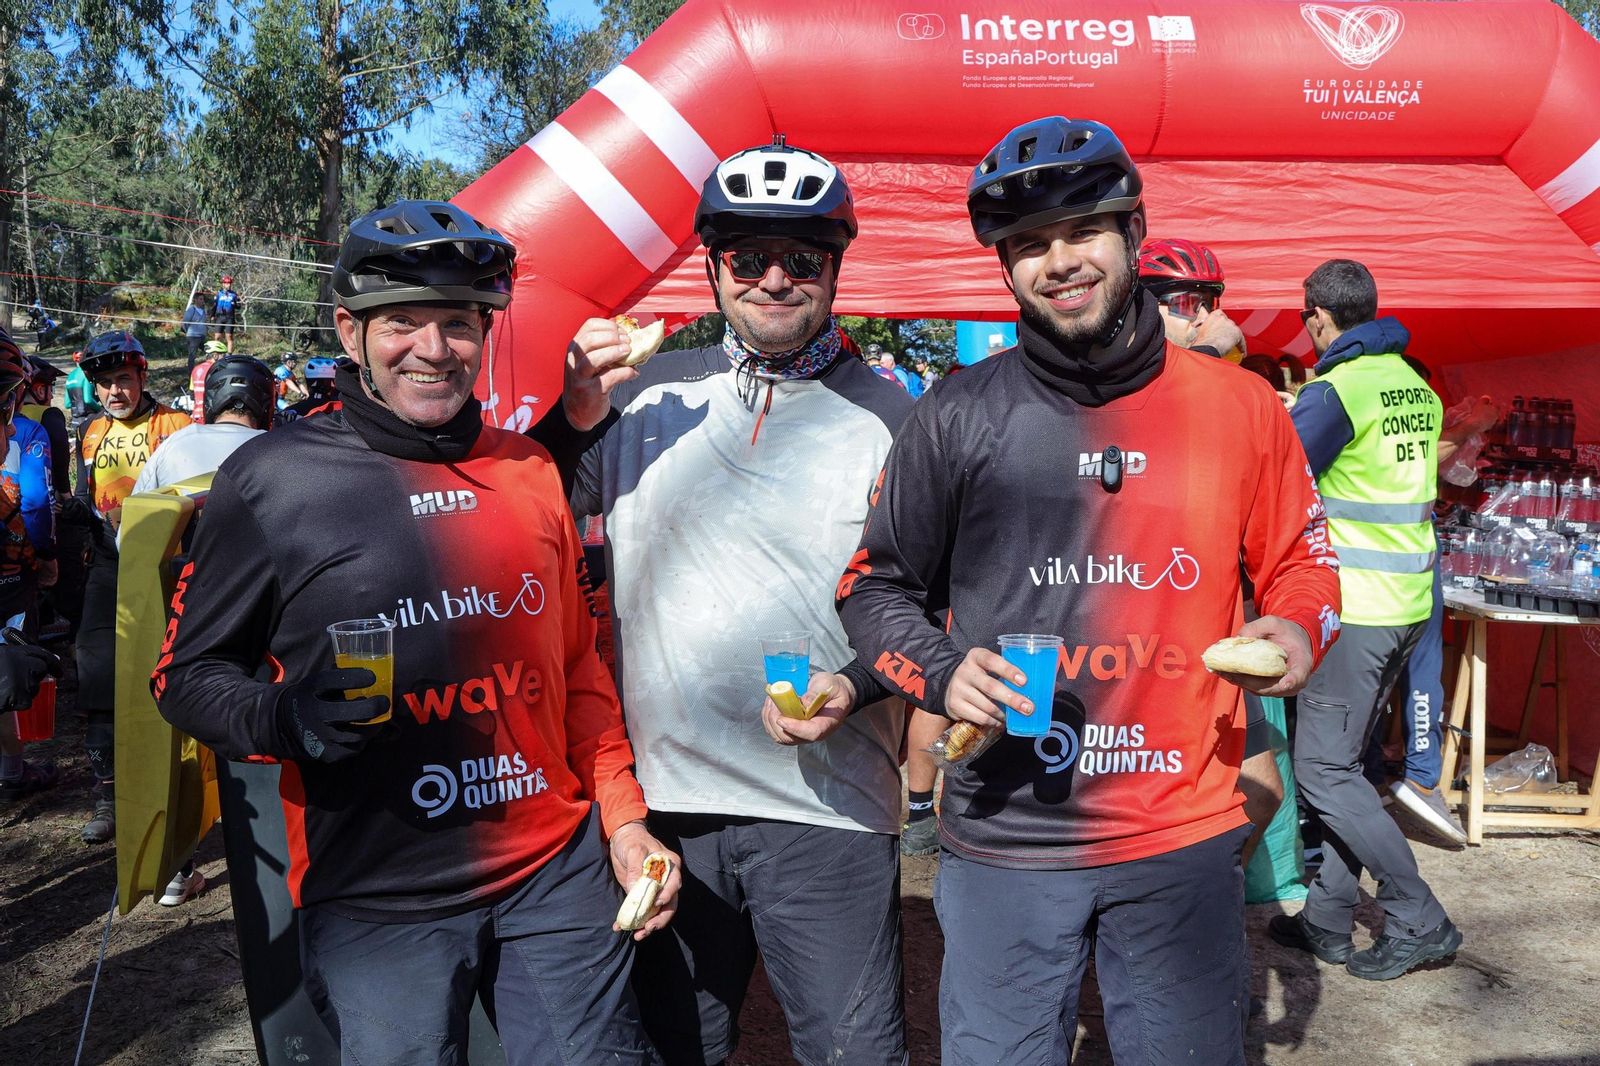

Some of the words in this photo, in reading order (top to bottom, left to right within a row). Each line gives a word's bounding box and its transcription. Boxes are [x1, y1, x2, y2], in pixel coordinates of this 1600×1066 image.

[960, 14, 1135, 46] Interreg
[962, 50, 1118, 68] EspañaPortugal
[1303, 79, 1423, 89] EUROCIDADE
[1303, 89, 1330, 103] TUI
[1343, 90, 1420, 107] VALENÇA
[1321, 110, 1396, 121] UNICIDADE
[1078, 451, 1147, 476] MD
[1396, 442, 1415, 462] DE
[409, 490, 478, 516] MUD
[1084, 724, 1145, 749] DUAS
[461, 752, 528, 784] DUAS
[1079, 750, 1182, 777] QUINTAS
